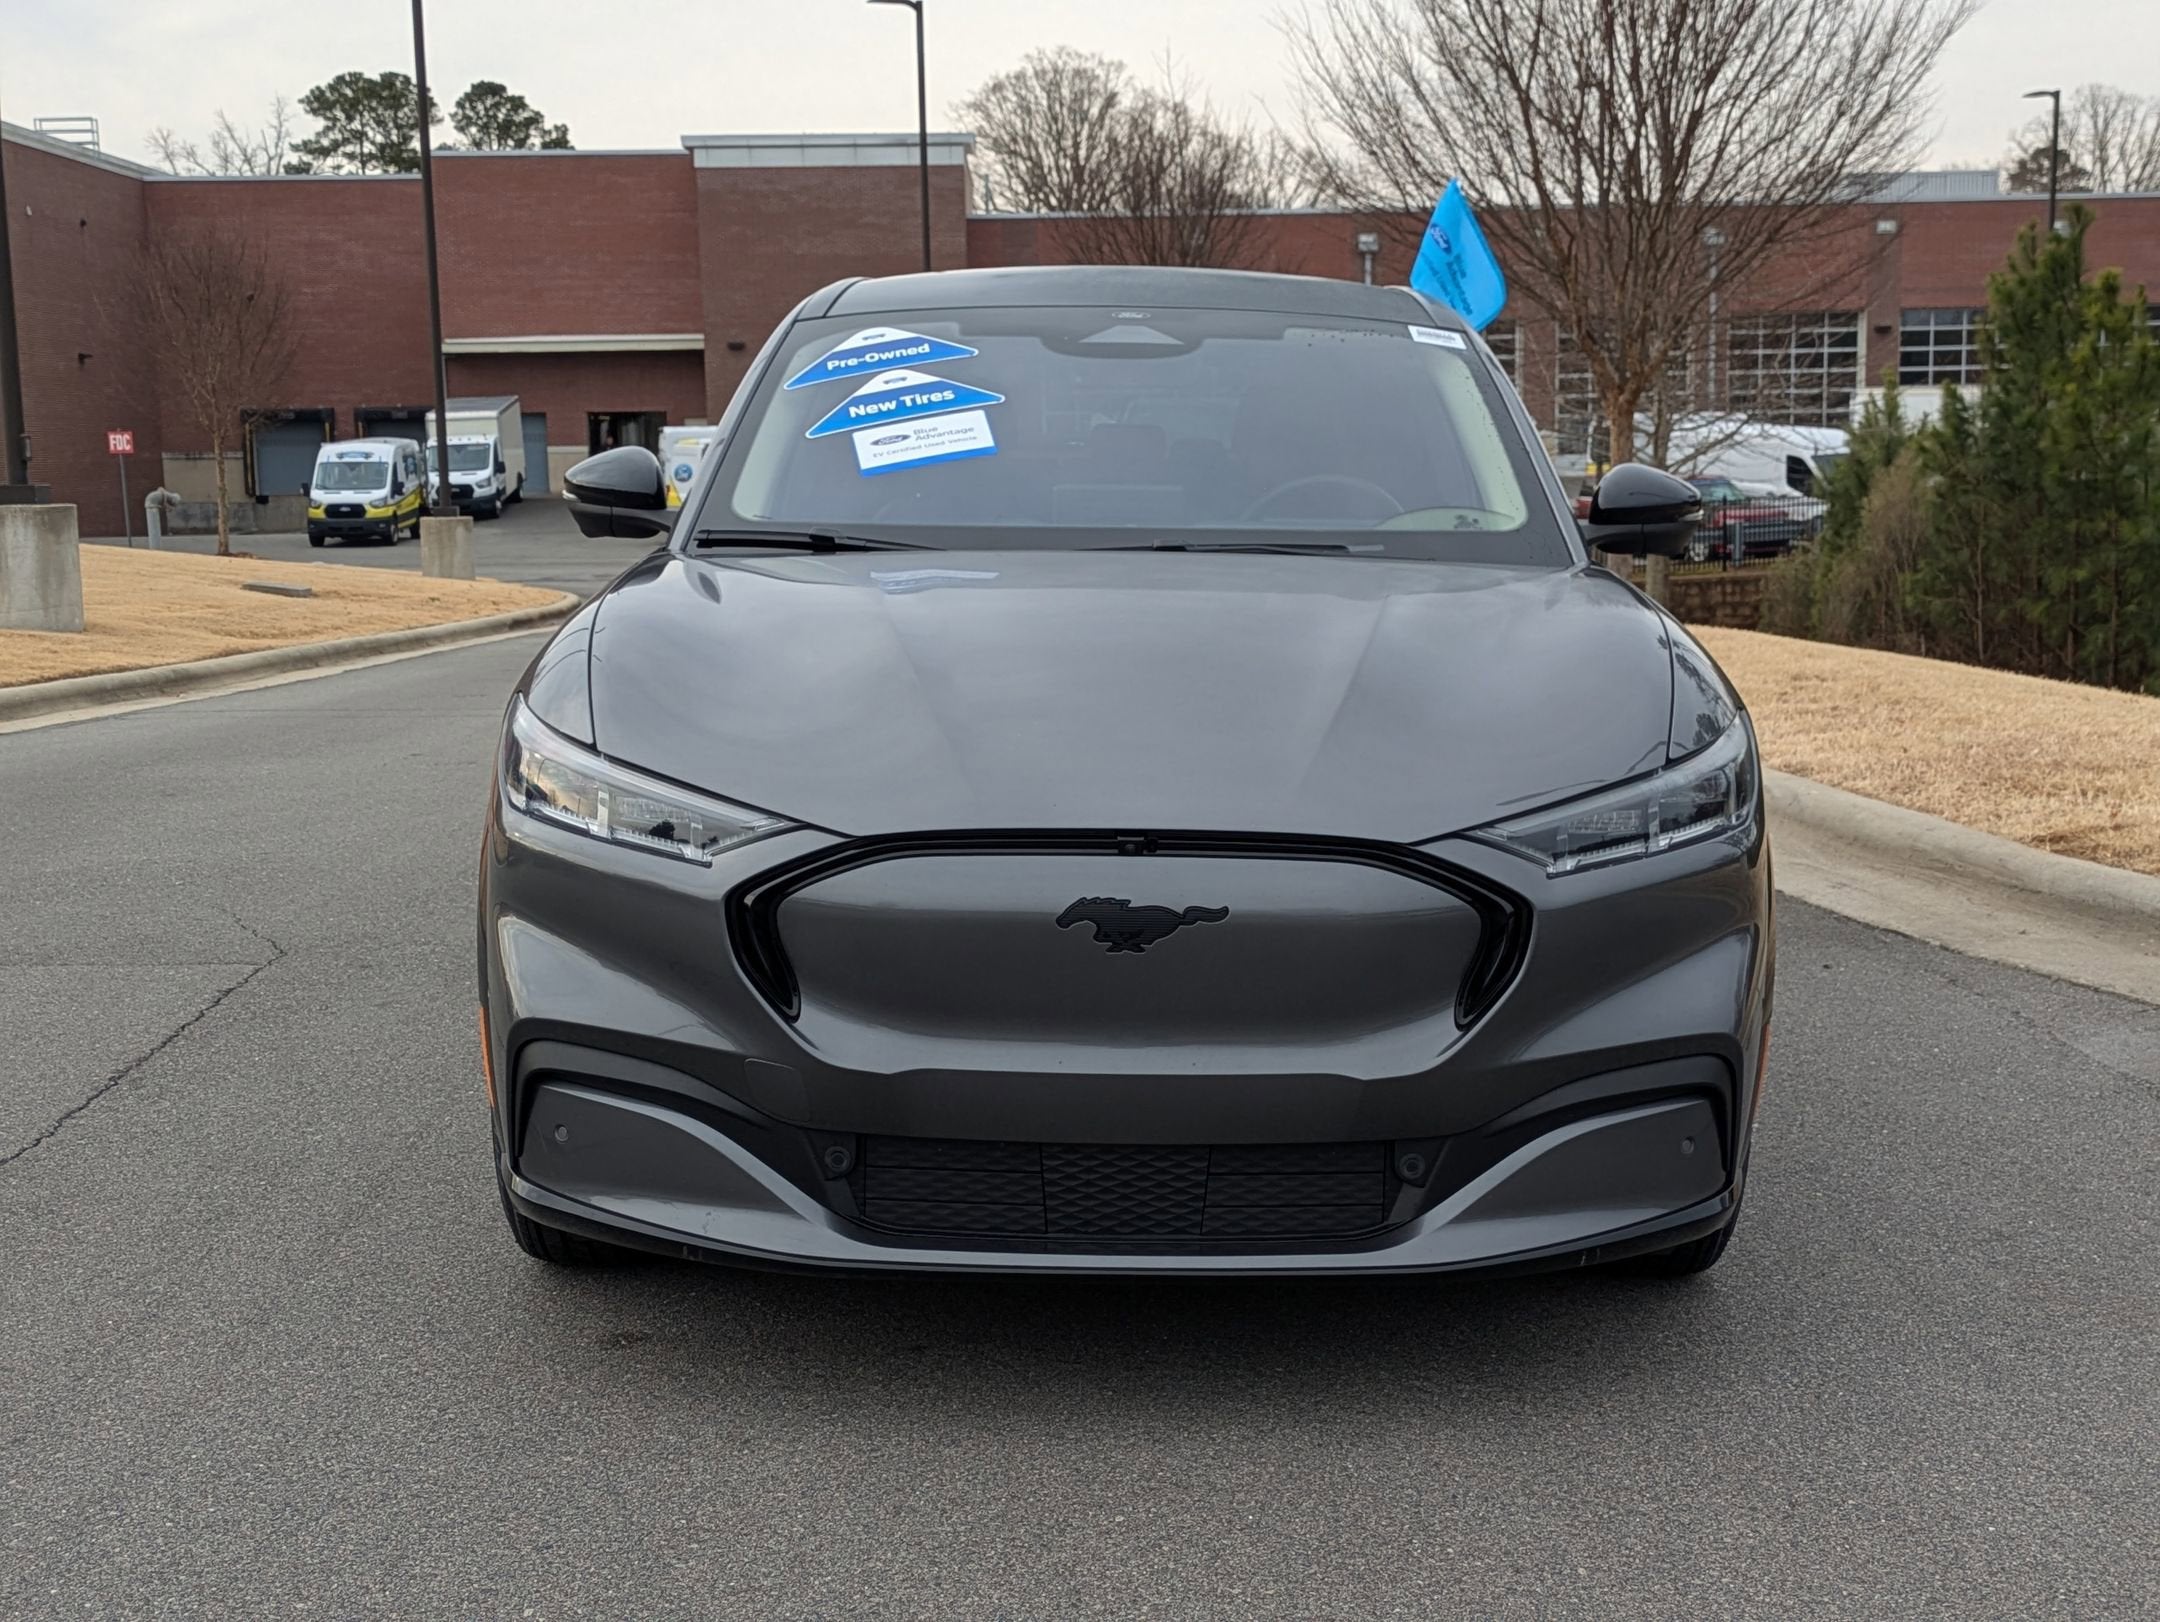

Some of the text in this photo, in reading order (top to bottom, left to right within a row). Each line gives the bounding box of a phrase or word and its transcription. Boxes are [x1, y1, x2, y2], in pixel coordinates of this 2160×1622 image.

[826, 343, 930, 370] Pre-Owned
[848, 390, 955, 418] New Tires
[912, 426, 939, 436] Blue
[914, 426, 975, 441] Advantage
[109, 434, 131, 450] FDC
